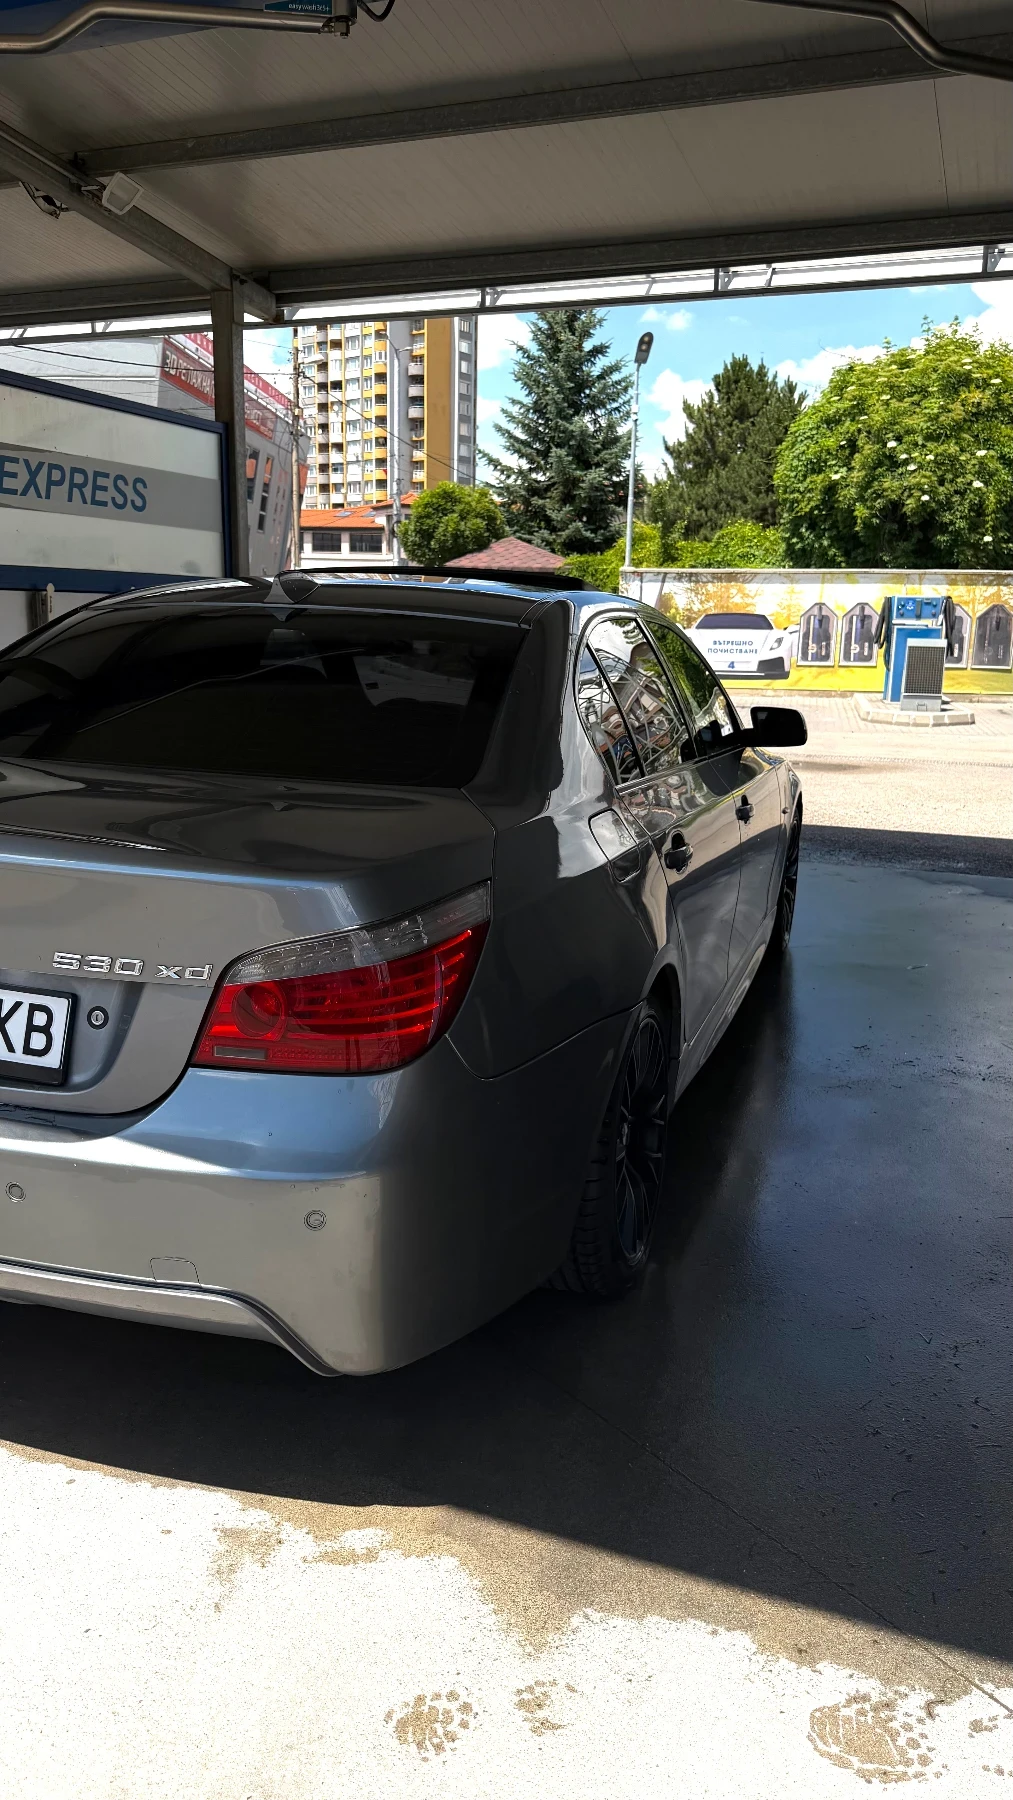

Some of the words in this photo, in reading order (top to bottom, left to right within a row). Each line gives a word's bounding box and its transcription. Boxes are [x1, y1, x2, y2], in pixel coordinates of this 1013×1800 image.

[0, 454, 148, 513] EXPRESS
[727, 661, 736, 669] 4
[52, 951, 145, 976] 530
[154, 964, 213, 980] xd
